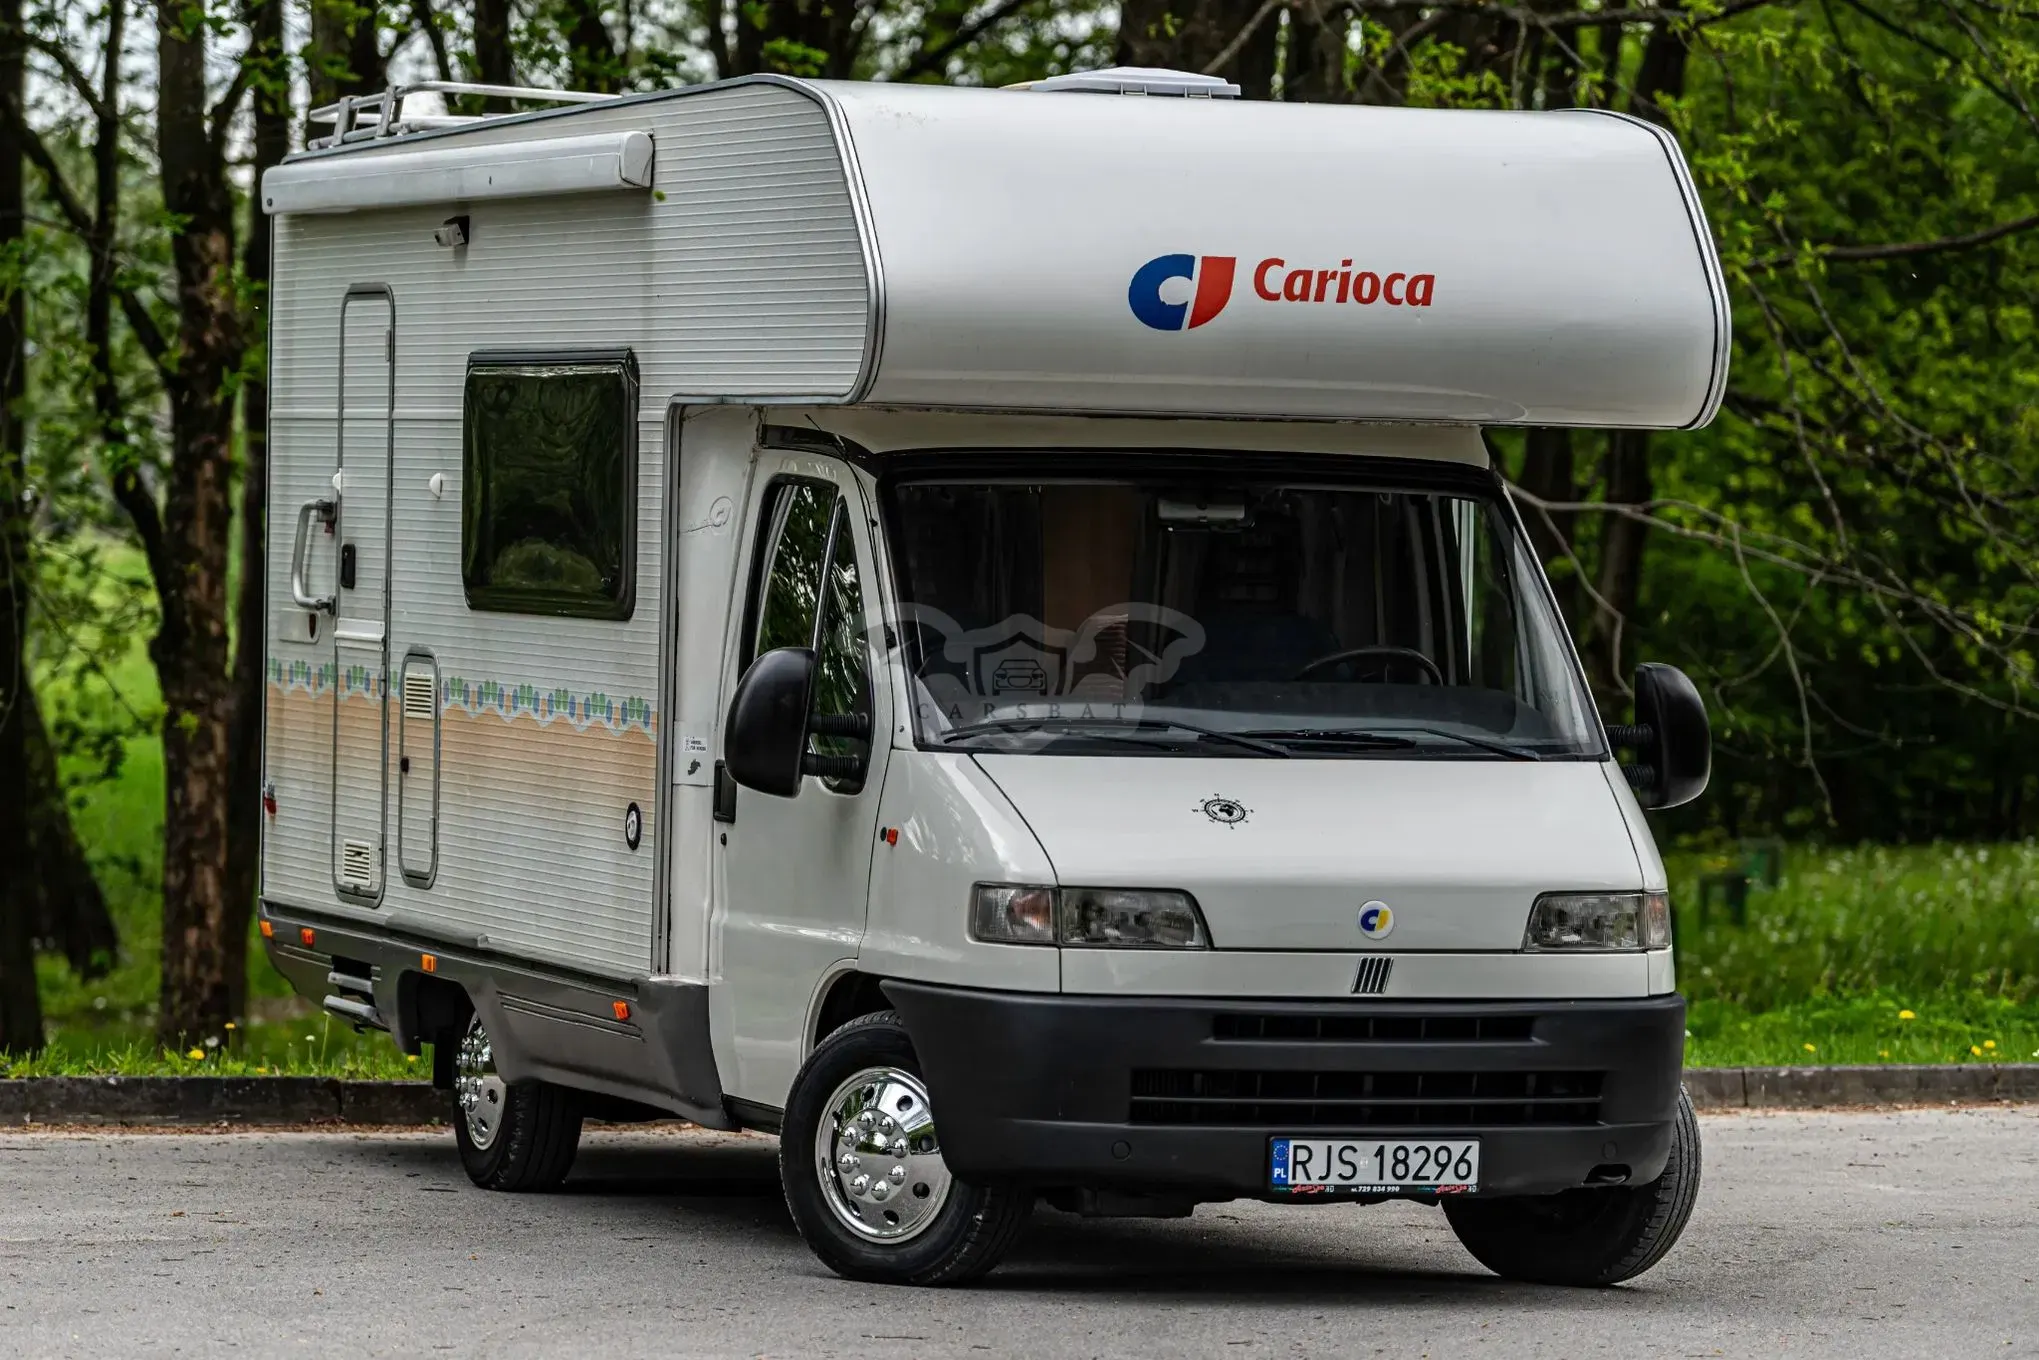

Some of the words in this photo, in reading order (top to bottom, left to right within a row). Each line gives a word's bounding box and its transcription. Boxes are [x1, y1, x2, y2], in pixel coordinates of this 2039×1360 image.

[1253, 257, 1435, 307] Carioca
[1273, 1167, 1287, 1179] PL
[1291, 1144, 1359, 1181] RJS
[1373, 1144, 1474, 1181] 18296
